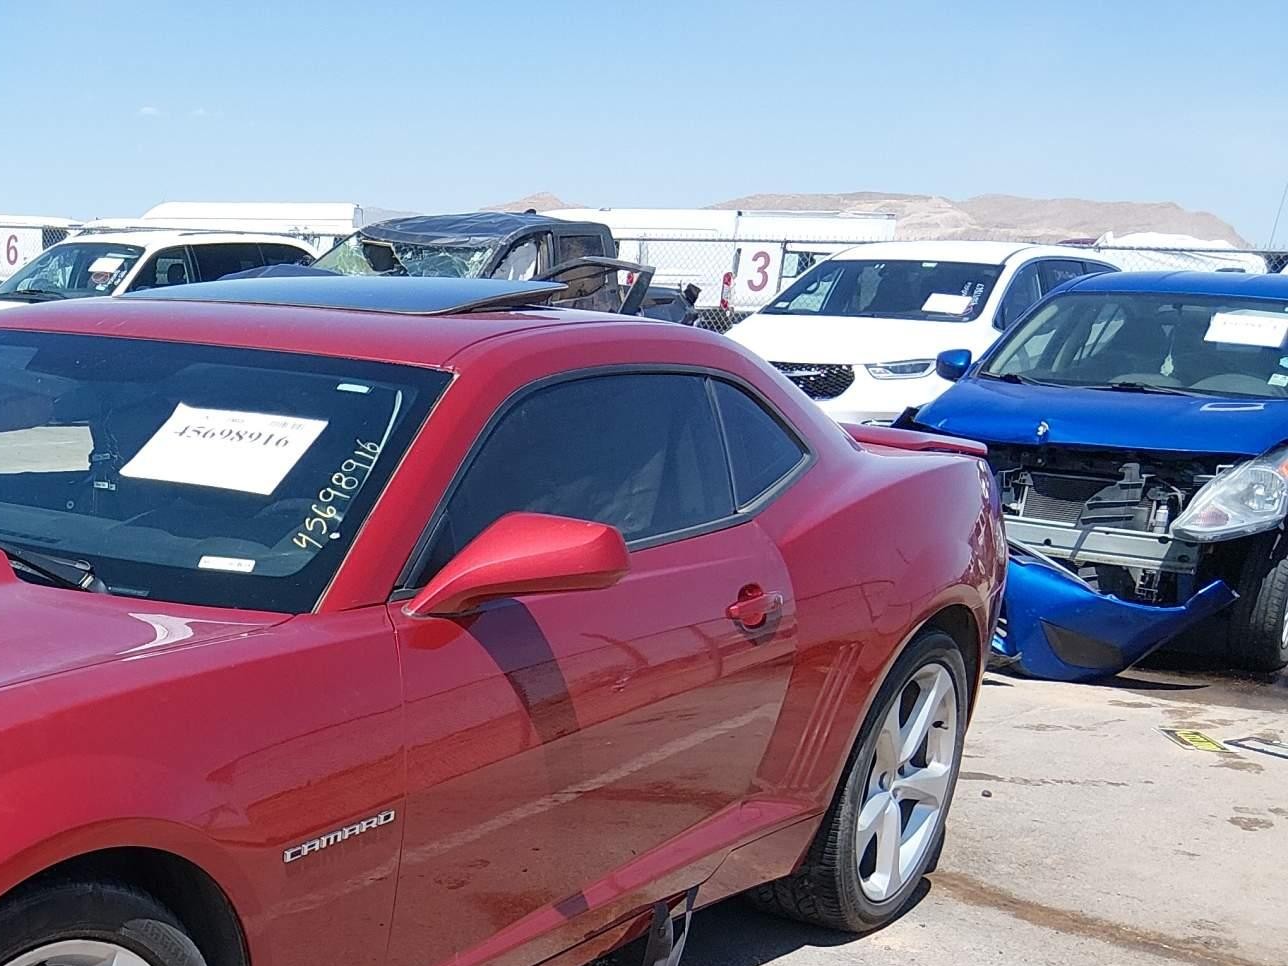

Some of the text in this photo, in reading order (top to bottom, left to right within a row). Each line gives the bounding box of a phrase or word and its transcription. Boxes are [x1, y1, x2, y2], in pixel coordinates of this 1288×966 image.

[6, 234, 18, 266] 6
[747, 250, 771, 292] 3
[174, 425, 289, 447] 45698916
[292, 438, 380, 549] 45698916
[283, 810, 395, 863] CAMARO
